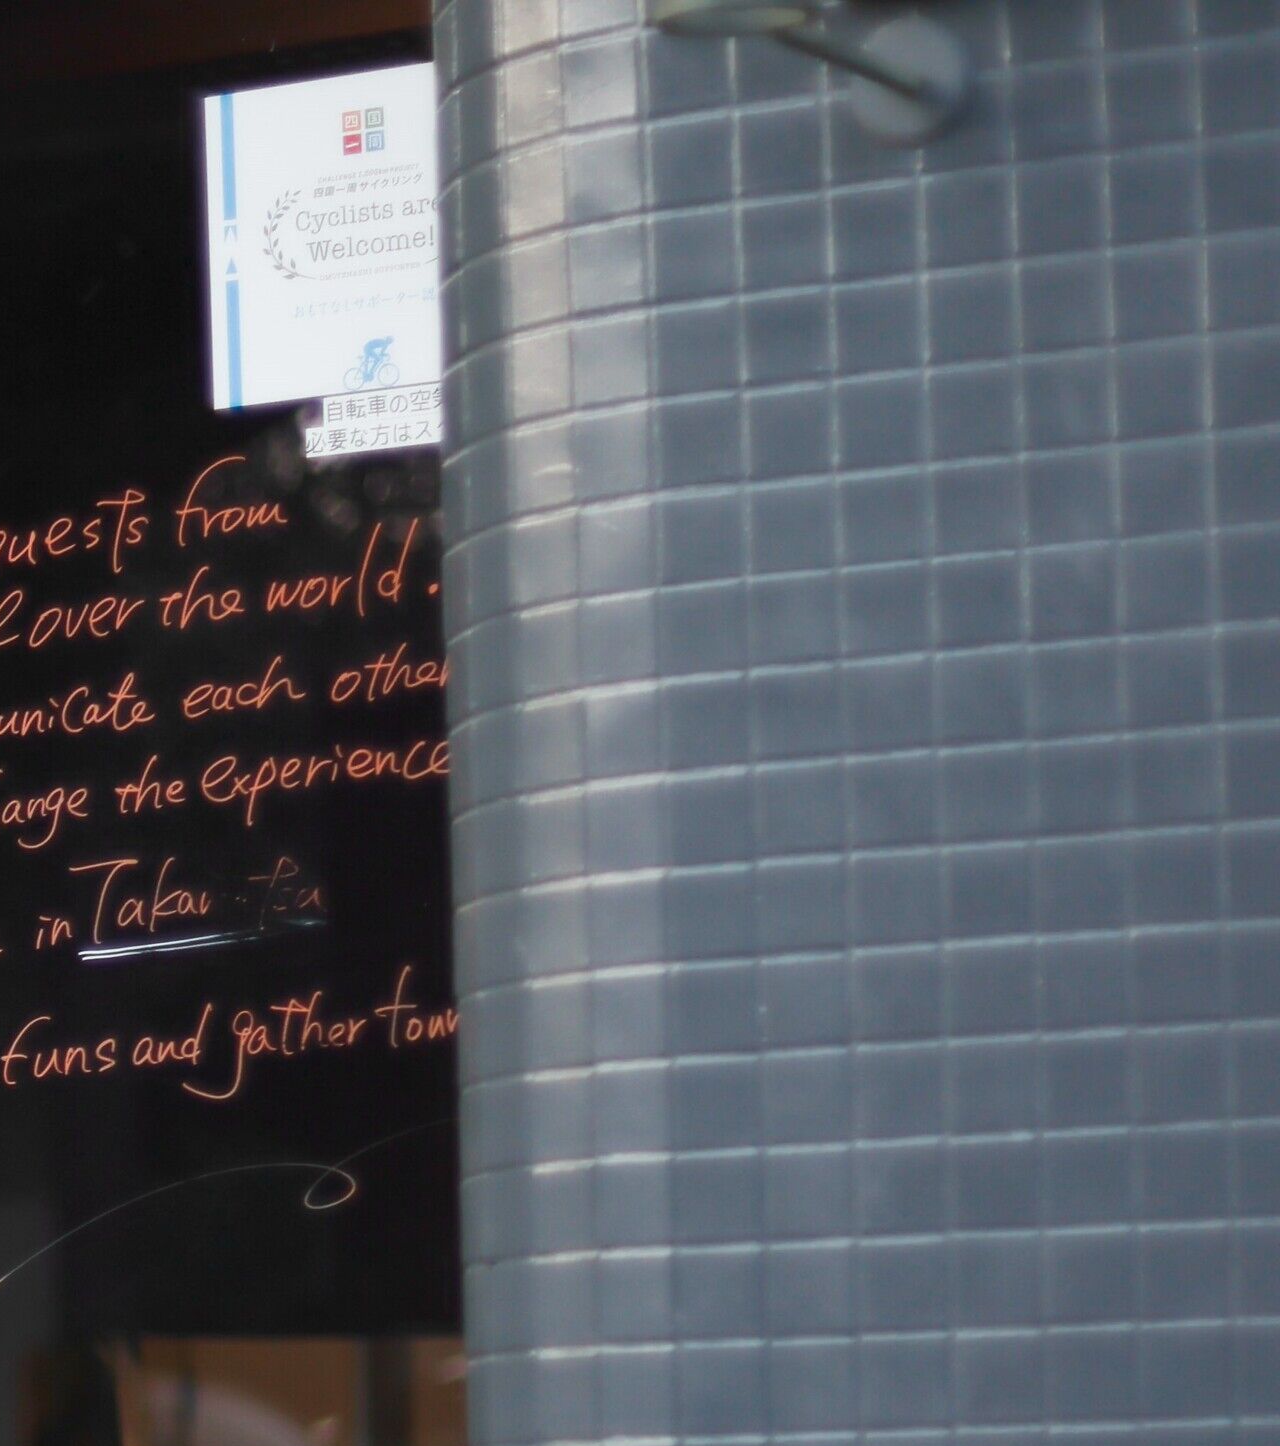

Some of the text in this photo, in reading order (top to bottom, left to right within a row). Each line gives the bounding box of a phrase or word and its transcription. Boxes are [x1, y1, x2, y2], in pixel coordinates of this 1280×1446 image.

[295, 201, 393, 235] Cyclists
[306, 225, 435, 264] Welcome!
[175, 455, 290, 547] from
[28, 593, 151, 647] over
[159, 565, 245, 631] the
[182, 654, 308, 721] each
[115, 756, 188, 817] the
[36, 914, 73, 953] in
[0, 1014, 115, 1084] funs
[132, 1004, 204, 1068] and
[182, 996, 368, 1100] gather
